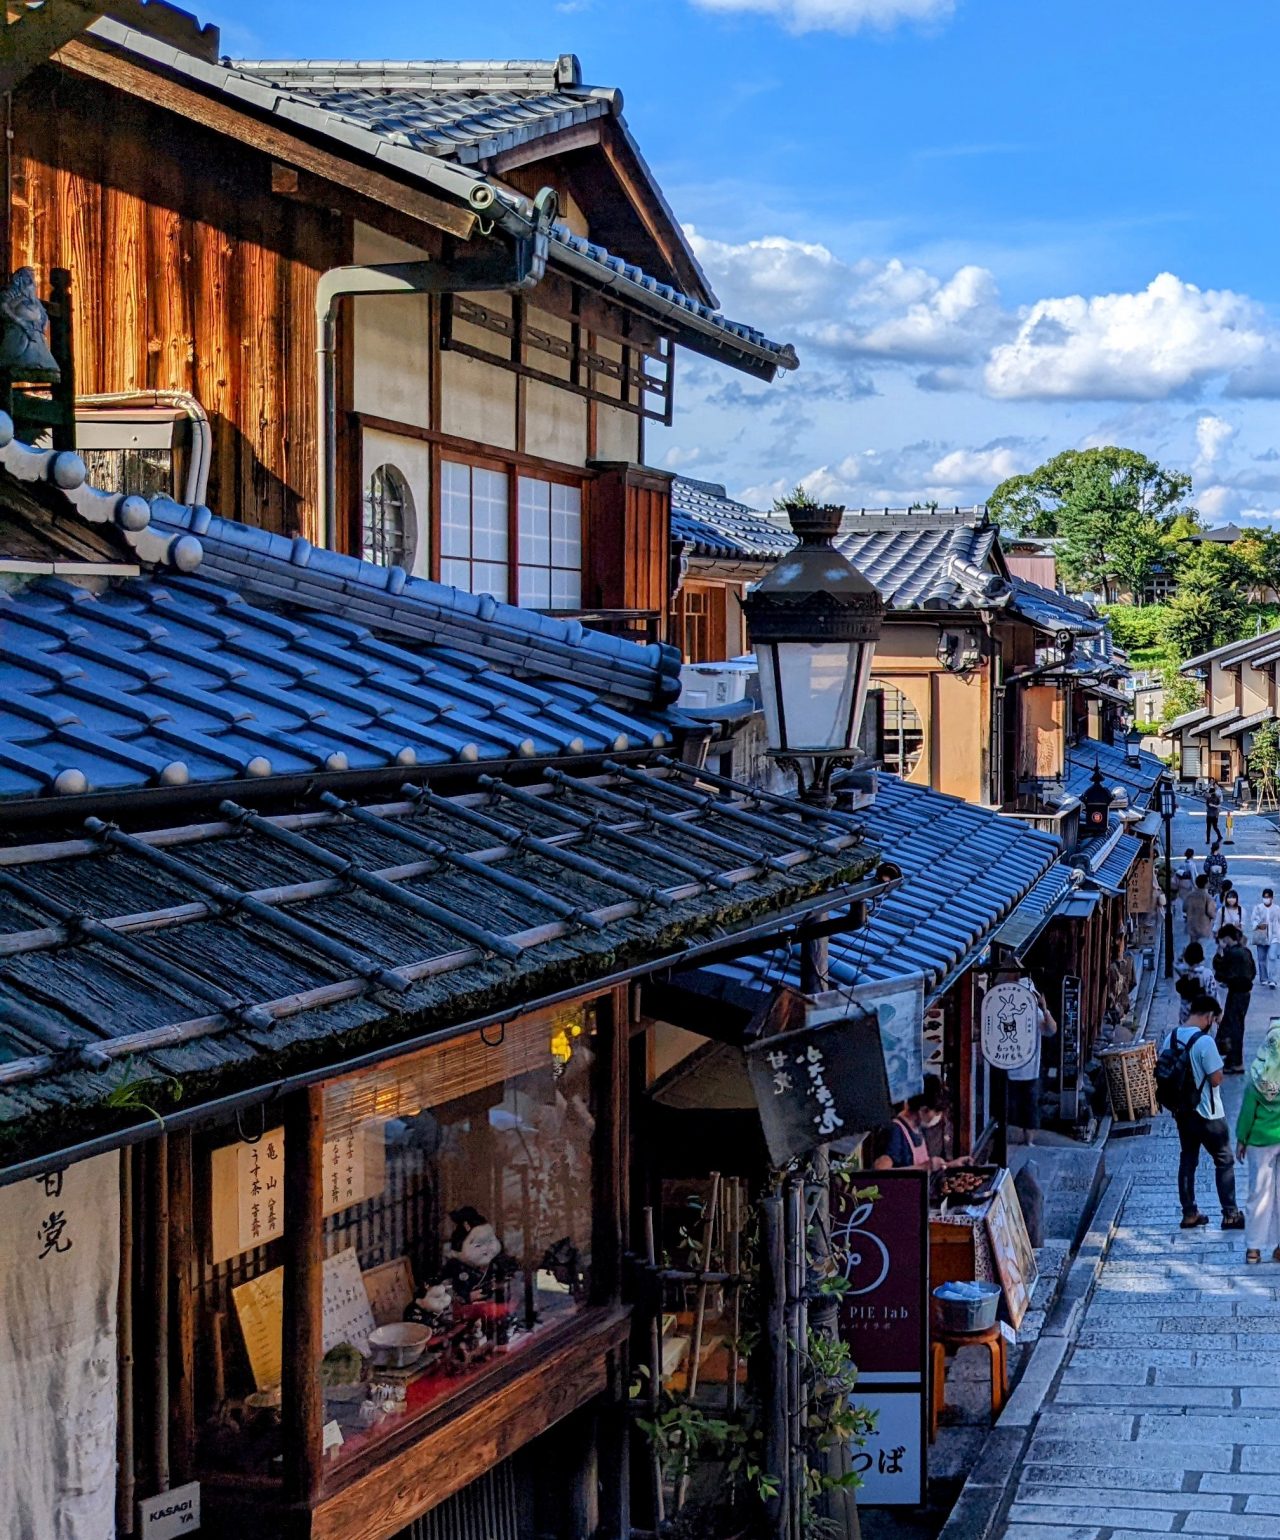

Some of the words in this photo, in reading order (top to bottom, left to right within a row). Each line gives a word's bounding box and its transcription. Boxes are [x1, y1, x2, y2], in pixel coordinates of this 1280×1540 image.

[850, 1306, 875, 1319] PIE
[884, 1306, 909, 1319] lab
[149, 1499, 192, 1523] KASAGI
[180, 1512, 194, 1524] YA
